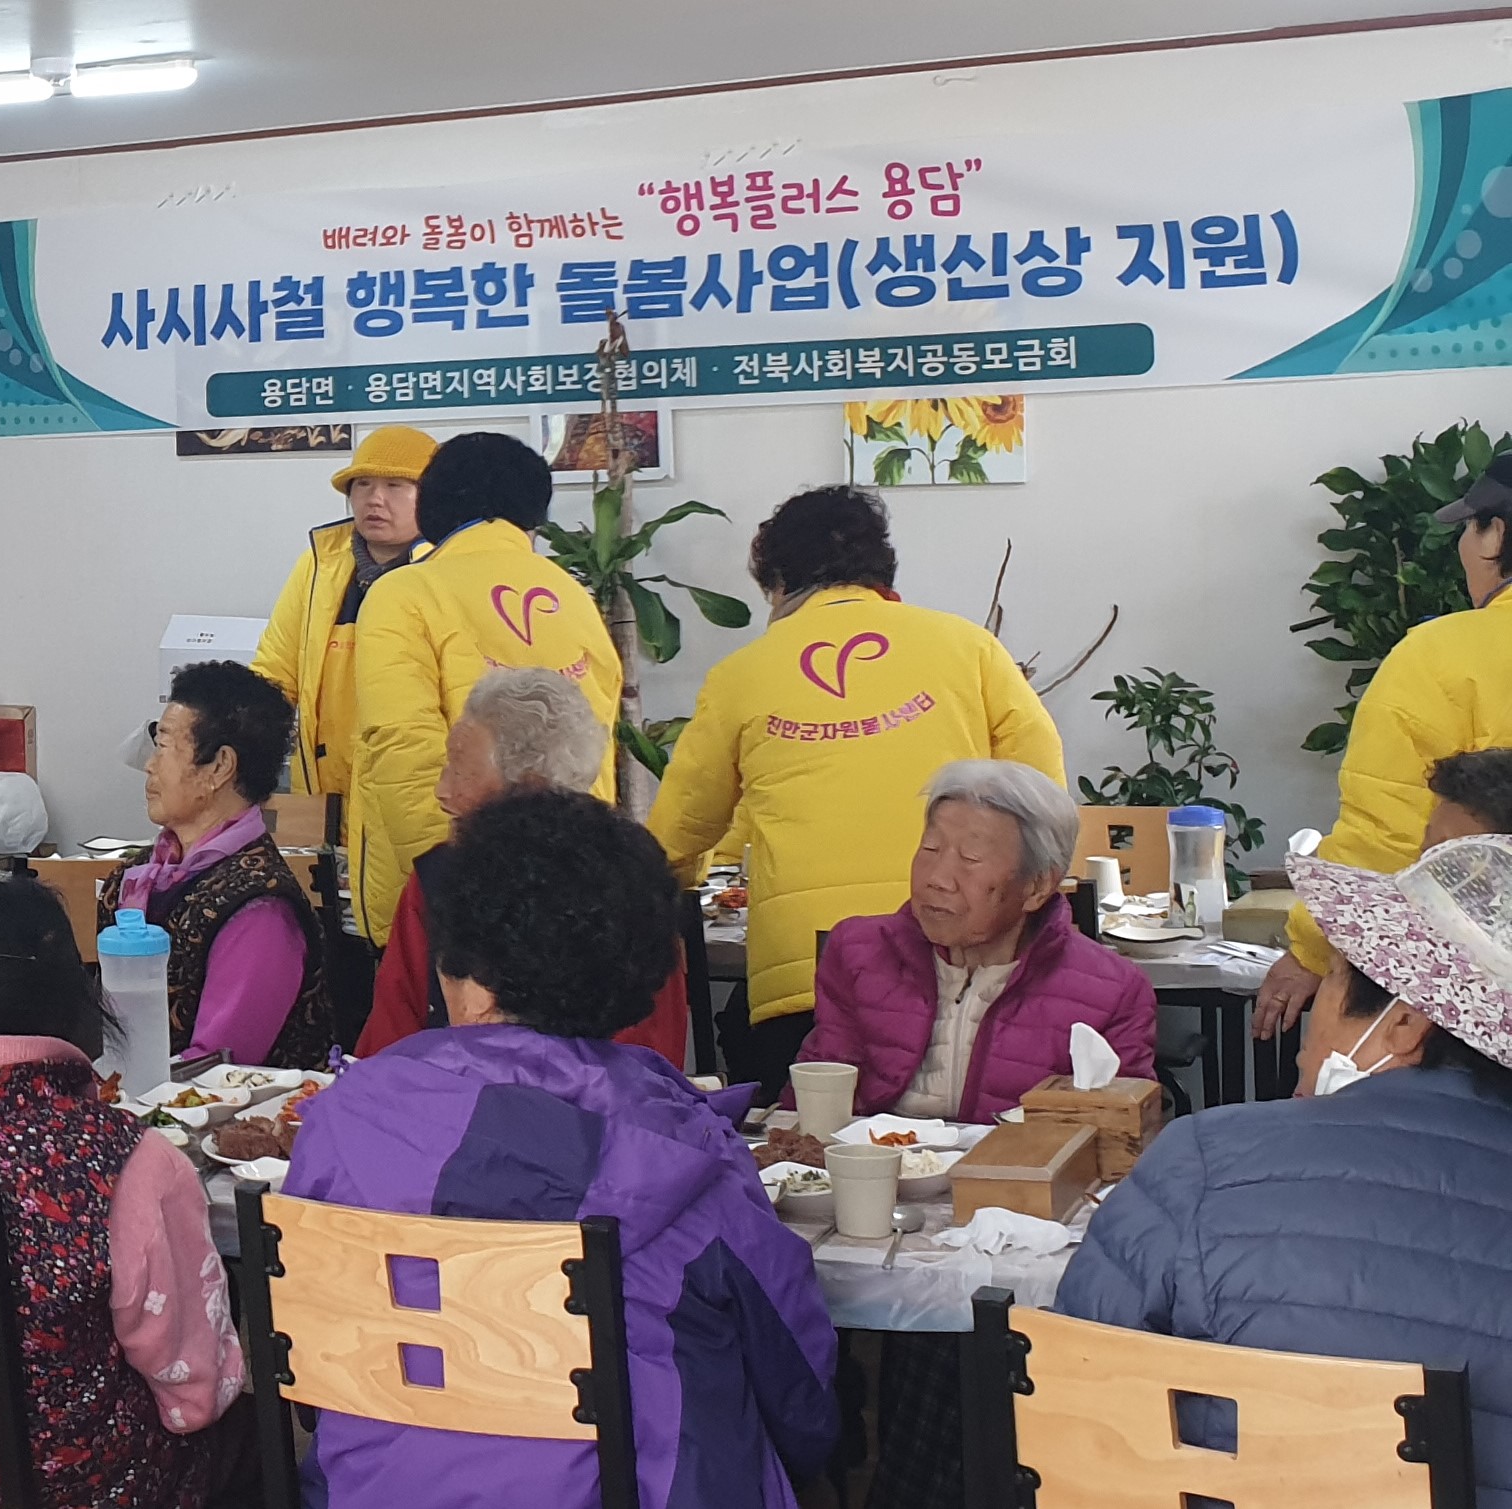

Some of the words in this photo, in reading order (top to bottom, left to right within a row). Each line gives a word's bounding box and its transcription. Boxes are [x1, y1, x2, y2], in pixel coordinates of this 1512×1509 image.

[322, 224, 411, 250] 배려와
[422, 214, 495, 250] 돌봄이
[505, 207, 625, 248] 함께하는
[101, 275, 326, 351] 사시사철
[345, 261, 535, 338] 행복한
[556, 226, 1092, 325] 돌봄사업(생신상
[1116, 209, 1299, 291] 지원)
[260, 376, 335, 408] 용담면
[364, 356, 698, 403] 용담면지역사회보장협의체
[733, 336, 1079, 386] 전북사회복지공동모금회
